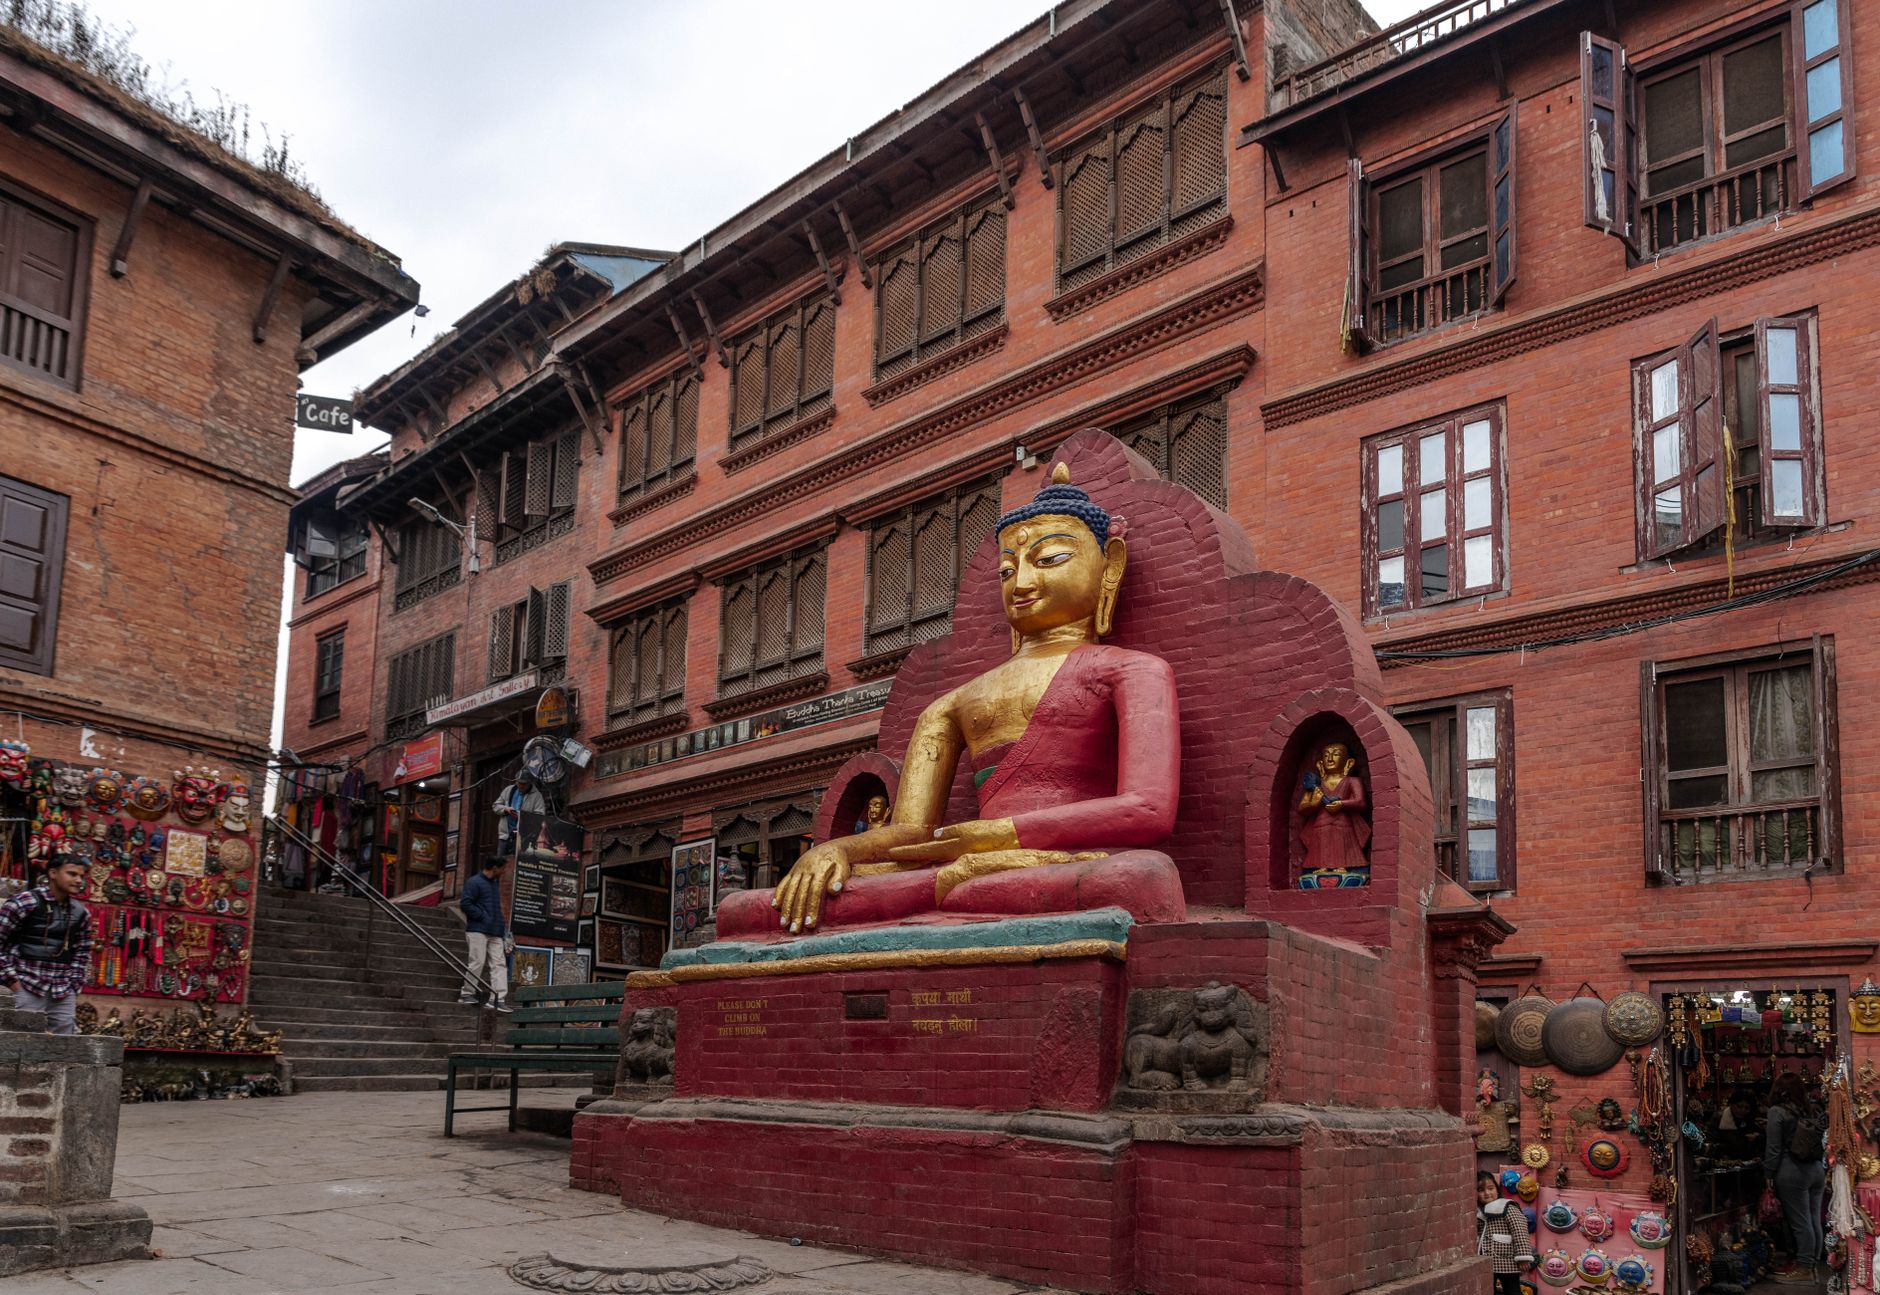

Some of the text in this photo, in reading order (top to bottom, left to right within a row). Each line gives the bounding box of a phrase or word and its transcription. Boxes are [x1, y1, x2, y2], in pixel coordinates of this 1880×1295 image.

[305, 403, 350, 426] Cafe
[430, 698, 476, 721] Himalayan
[479, 690, 495, 704] Art
[785, 704, 819, 719] Buddha
[717, 1000, 744, 1010] PLEASE
[911, 991, 942, 1010] कृपया
[724, 1012, 761, 1023] CLIMB ON
[719, 1025, 767, 1037] THE BUDDHA
